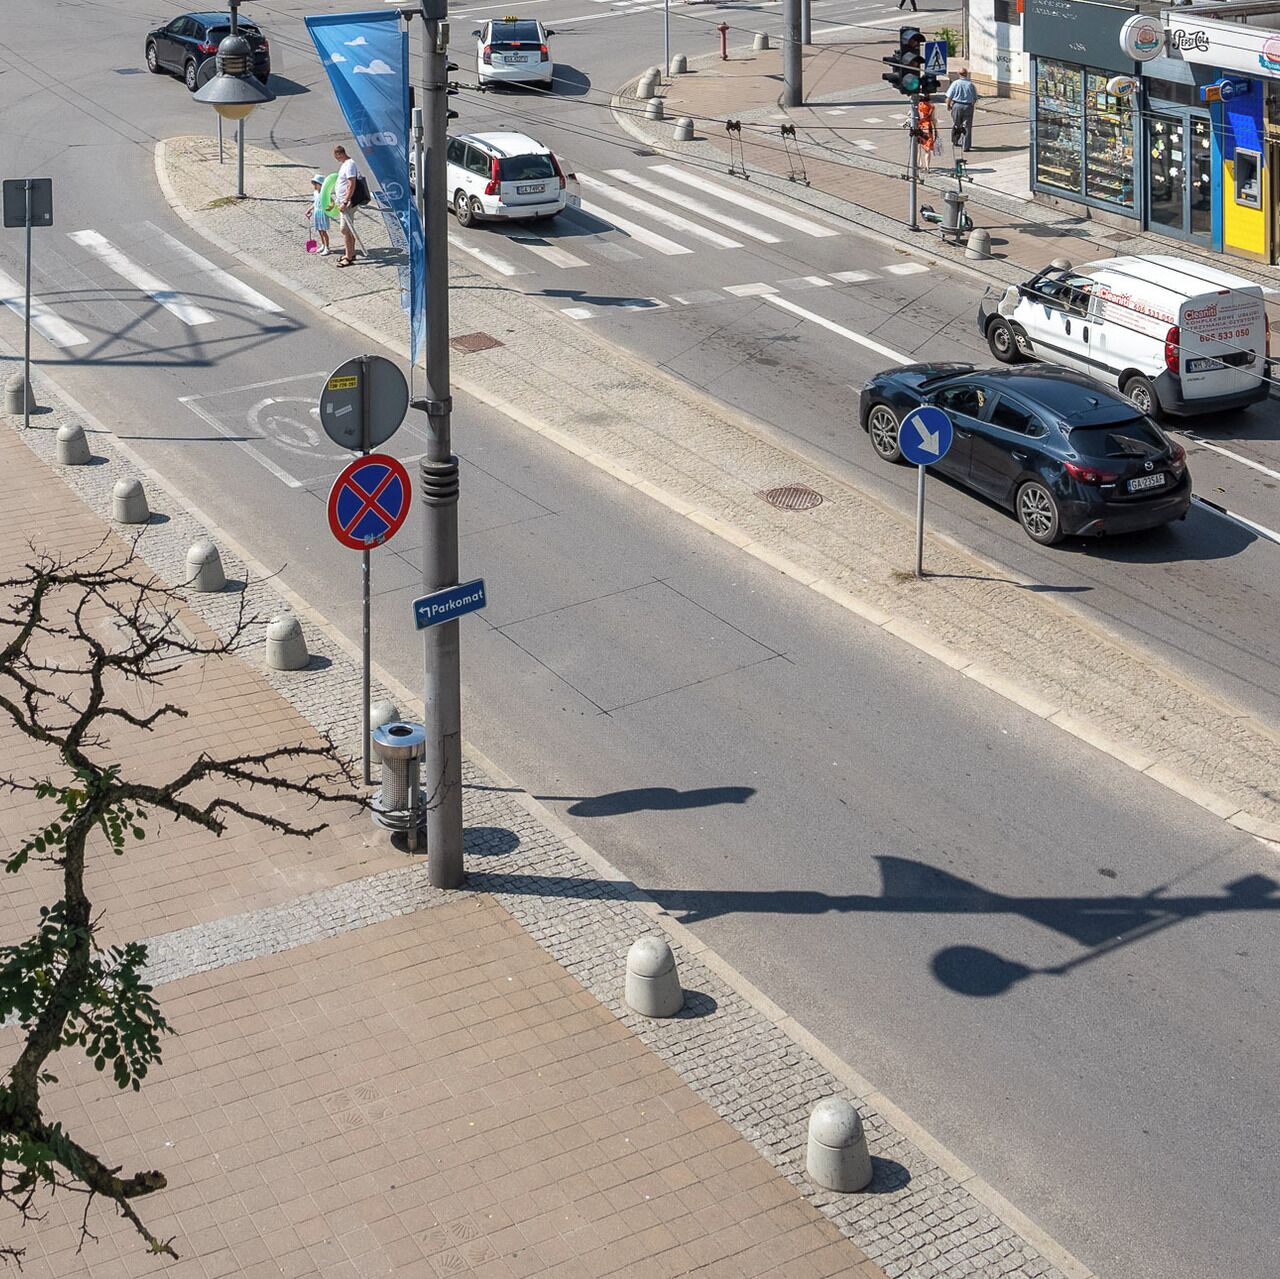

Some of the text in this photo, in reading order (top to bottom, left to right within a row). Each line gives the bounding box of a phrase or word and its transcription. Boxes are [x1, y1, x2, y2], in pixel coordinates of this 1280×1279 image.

[1185, 304, 1217, 320] Cleaniti
[1219, 331, 1233, 340] 533
[1235, 328, 1249, 337] 050
[432, 589, 484, 615] Parkomat
